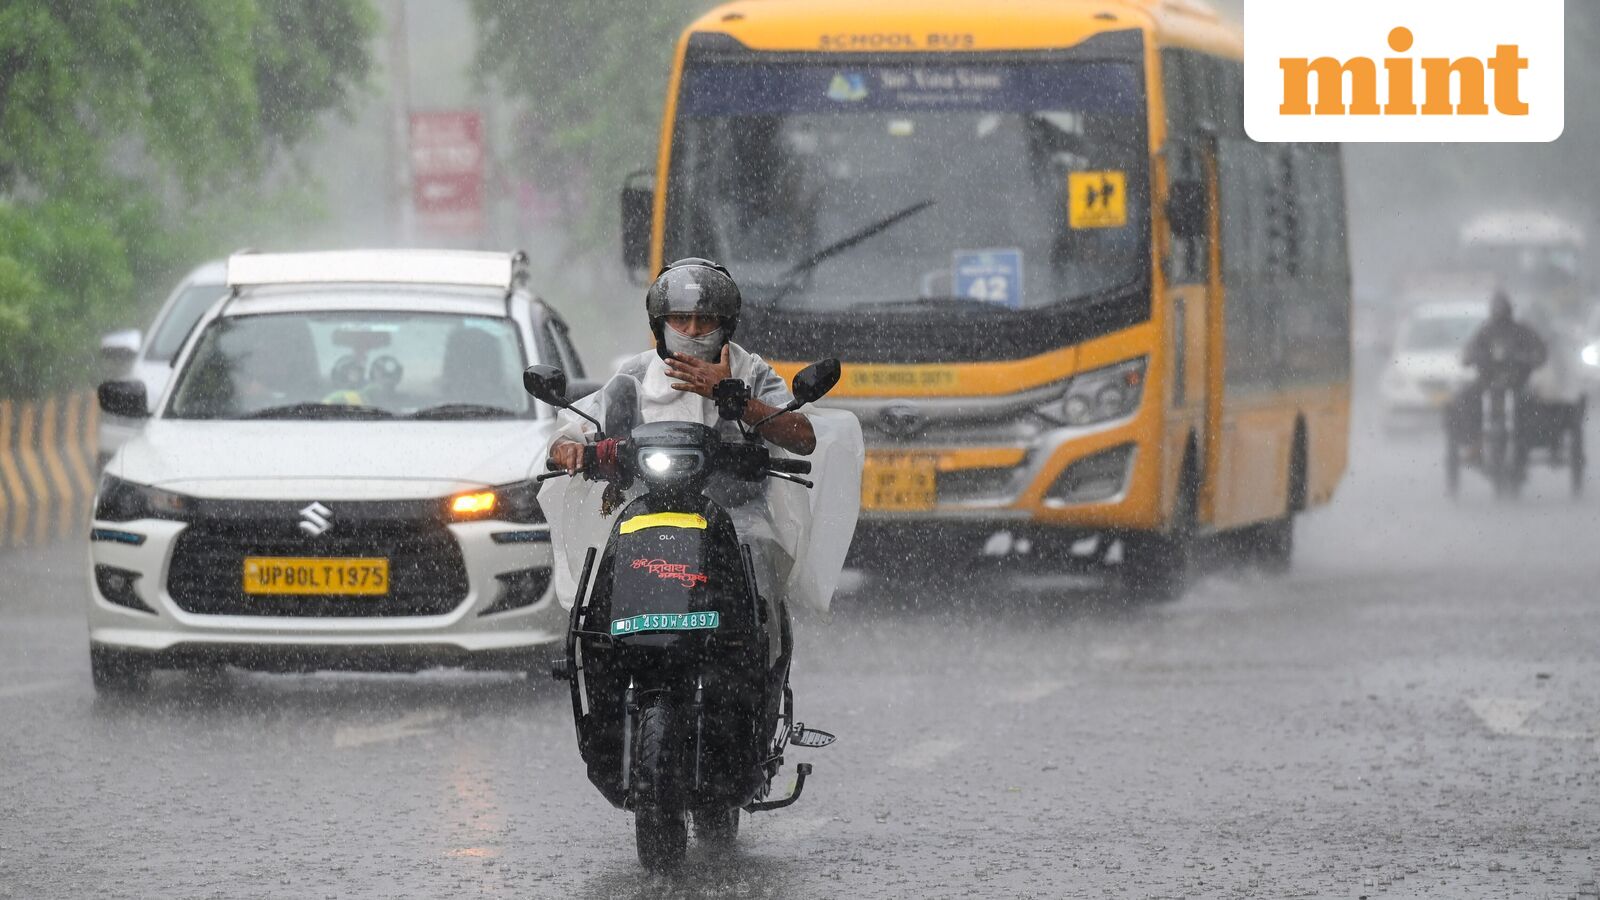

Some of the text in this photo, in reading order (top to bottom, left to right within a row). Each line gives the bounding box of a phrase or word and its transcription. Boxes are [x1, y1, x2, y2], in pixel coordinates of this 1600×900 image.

[819, 34, 974, 49] SCHOOL BUS
[968, 276, 1008, 301] 42
[681, 613, 716, 627] 4897
